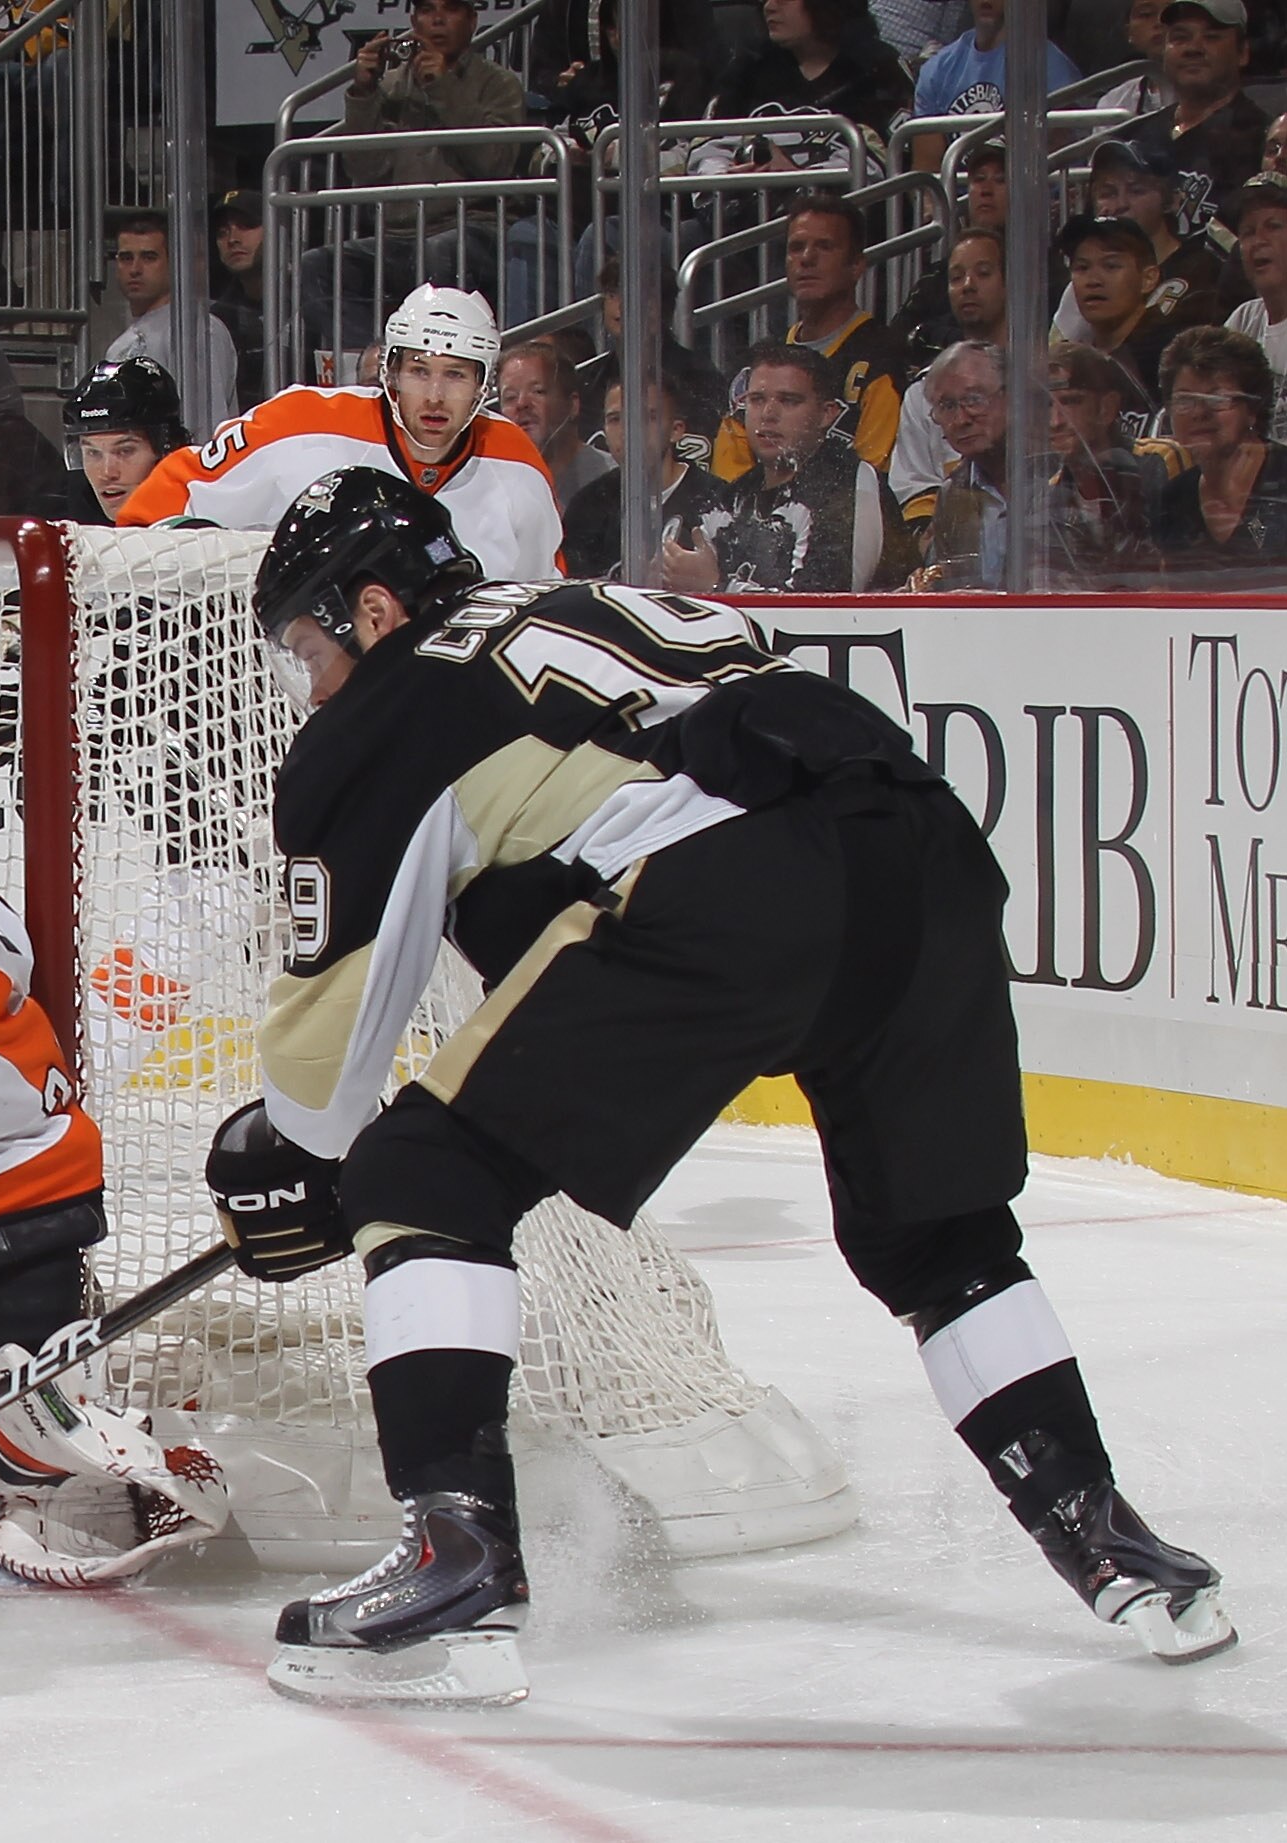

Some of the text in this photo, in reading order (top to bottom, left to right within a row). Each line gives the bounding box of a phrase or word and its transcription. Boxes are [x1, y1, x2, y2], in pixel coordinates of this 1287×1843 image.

[224, 191, 239, 205] P
[844, 361, 870, 404] C
[81, 408, 110, 419] Reebok
[200, 420, 247, 471] 5
[415, 579, 562, 664] COM
[1188, 633, 1287, 812] TO
